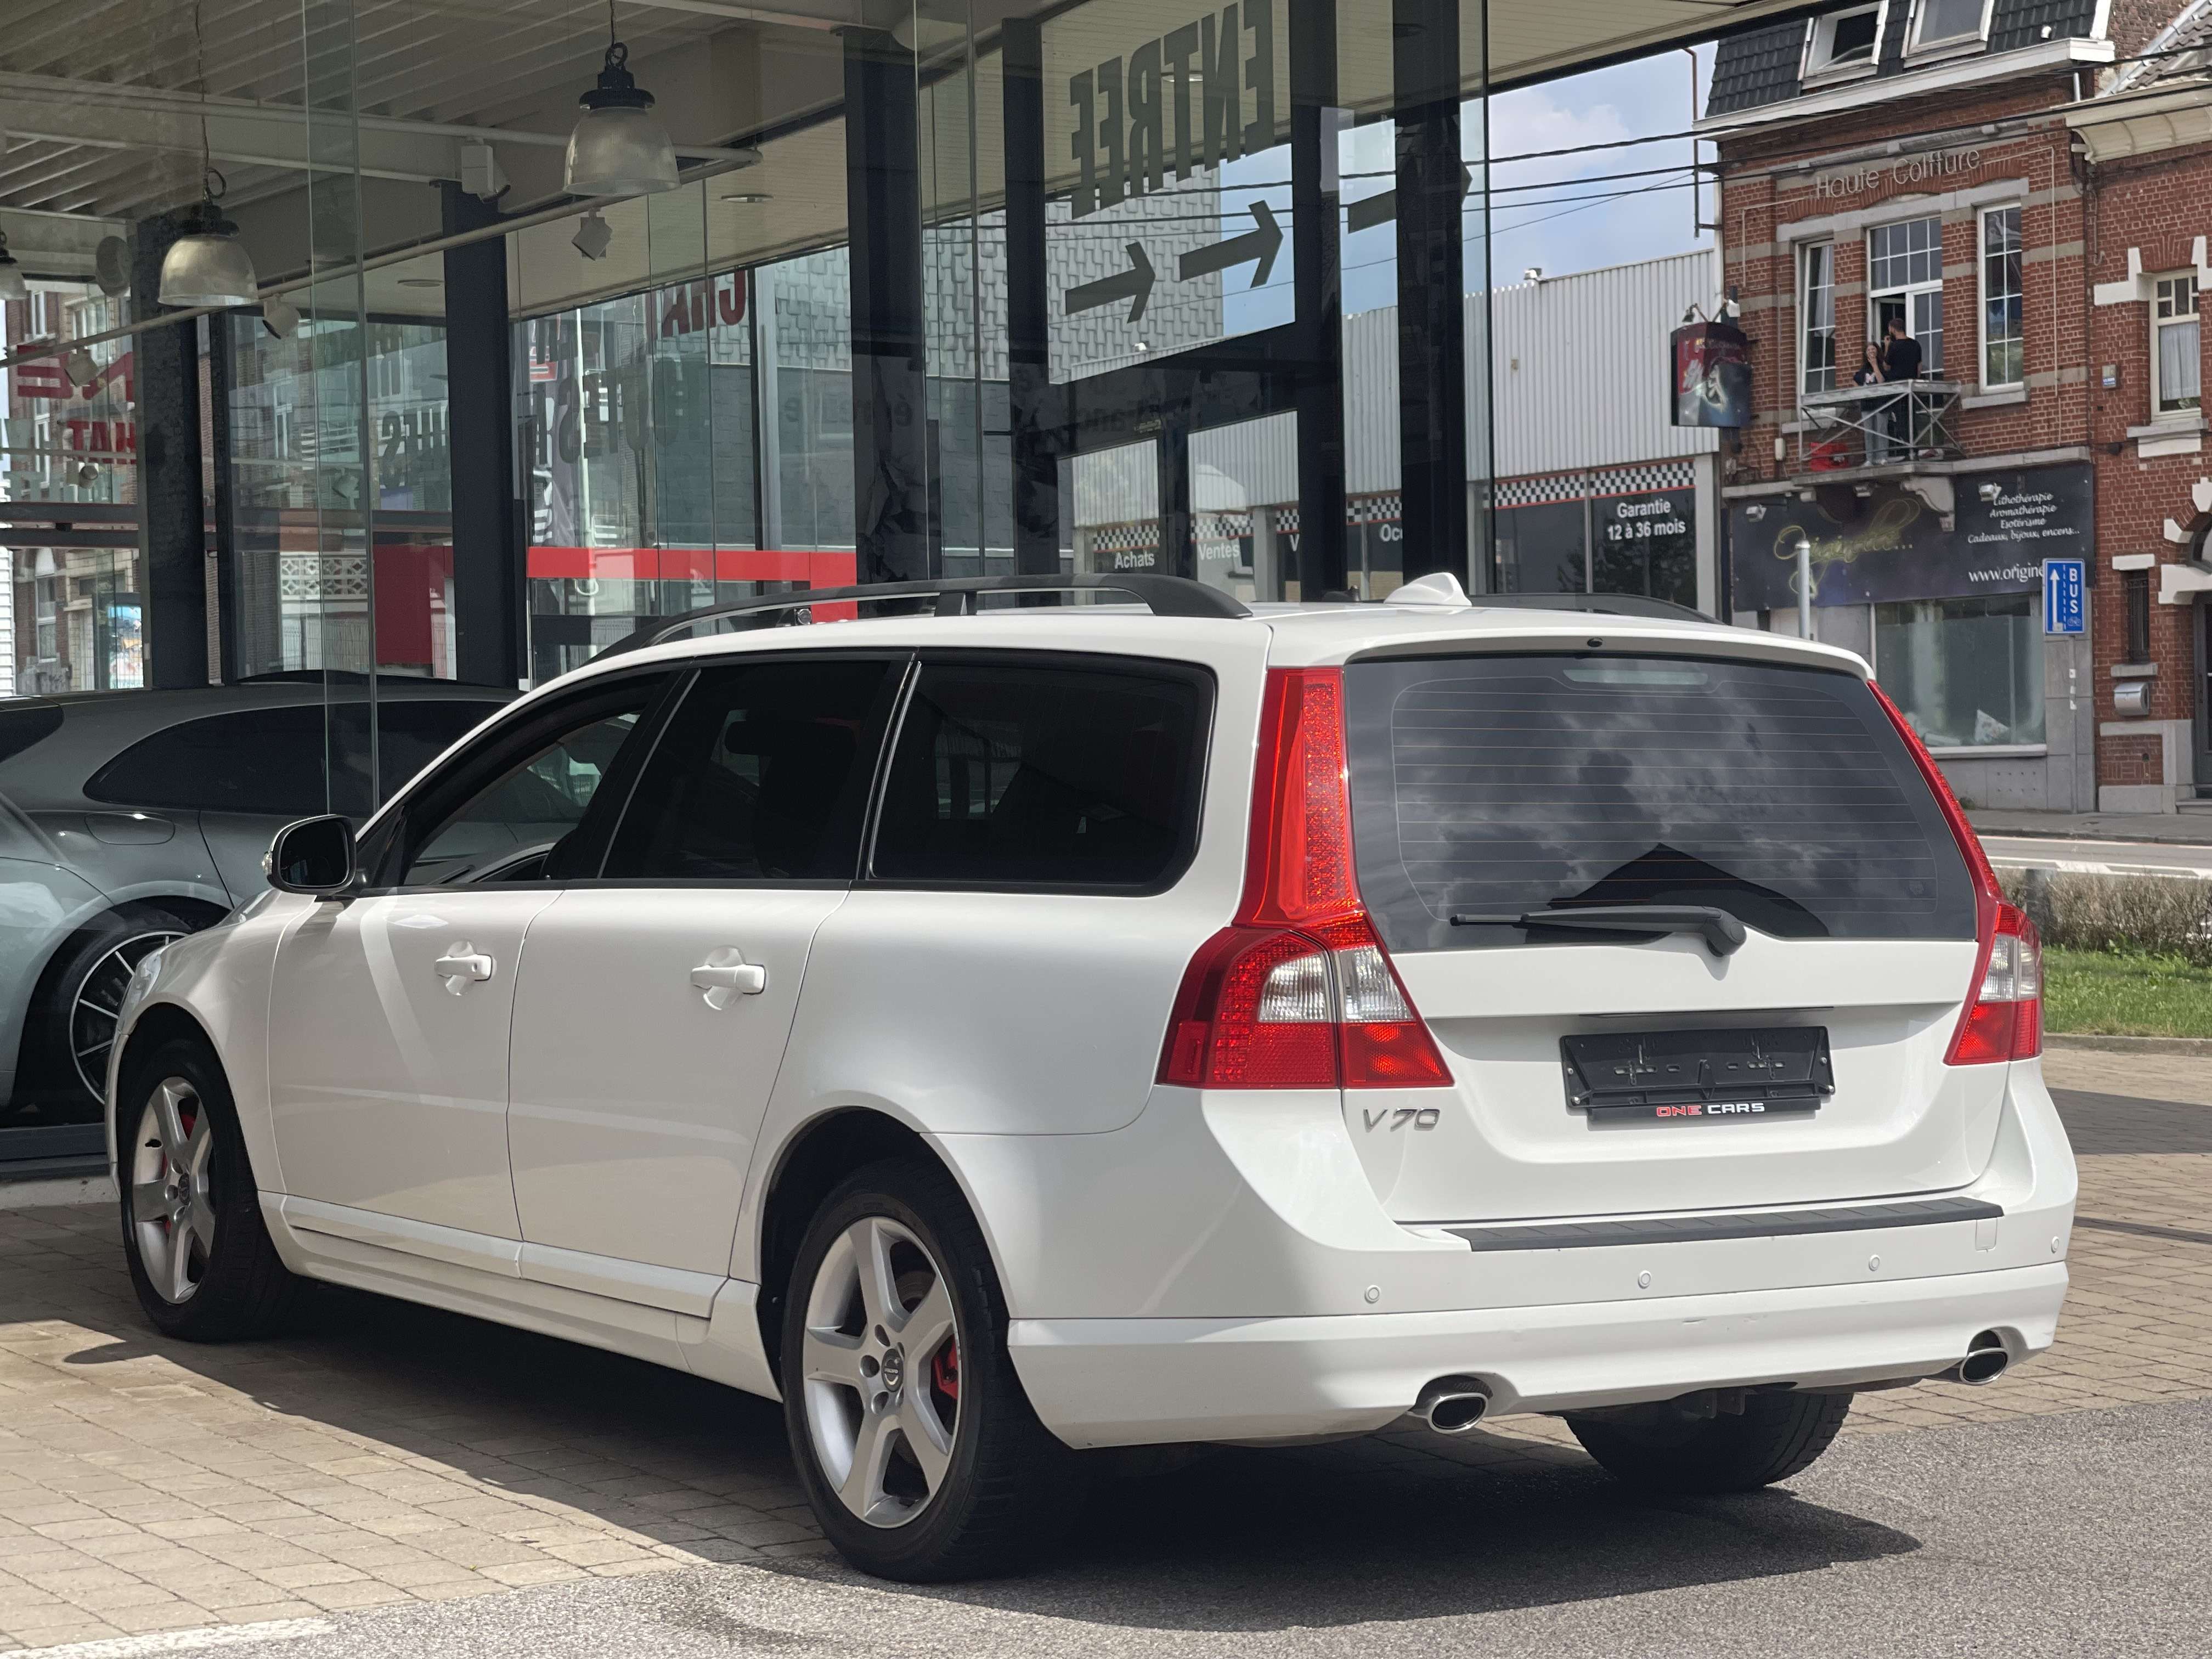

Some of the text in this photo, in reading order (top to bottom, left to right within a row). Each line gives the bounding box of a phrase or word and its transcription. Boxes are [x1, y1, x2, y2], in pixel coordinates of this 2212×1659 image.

[1816, 149, 1980, 200] Haute Coiffure
[1617, 498, 1671, 518] Garantie
[1989, 505, 2057, 518] Aromathérapie
[1607, 518, 1686, 540] 12 à 36 mois
[1114, 551, 1155, 569] Achats
[1198, 542, 1241, 560] Ventes
[2069, 567, 2079, 614] BUS
[1656, 1102, 1765, 1117] ONE CARS
